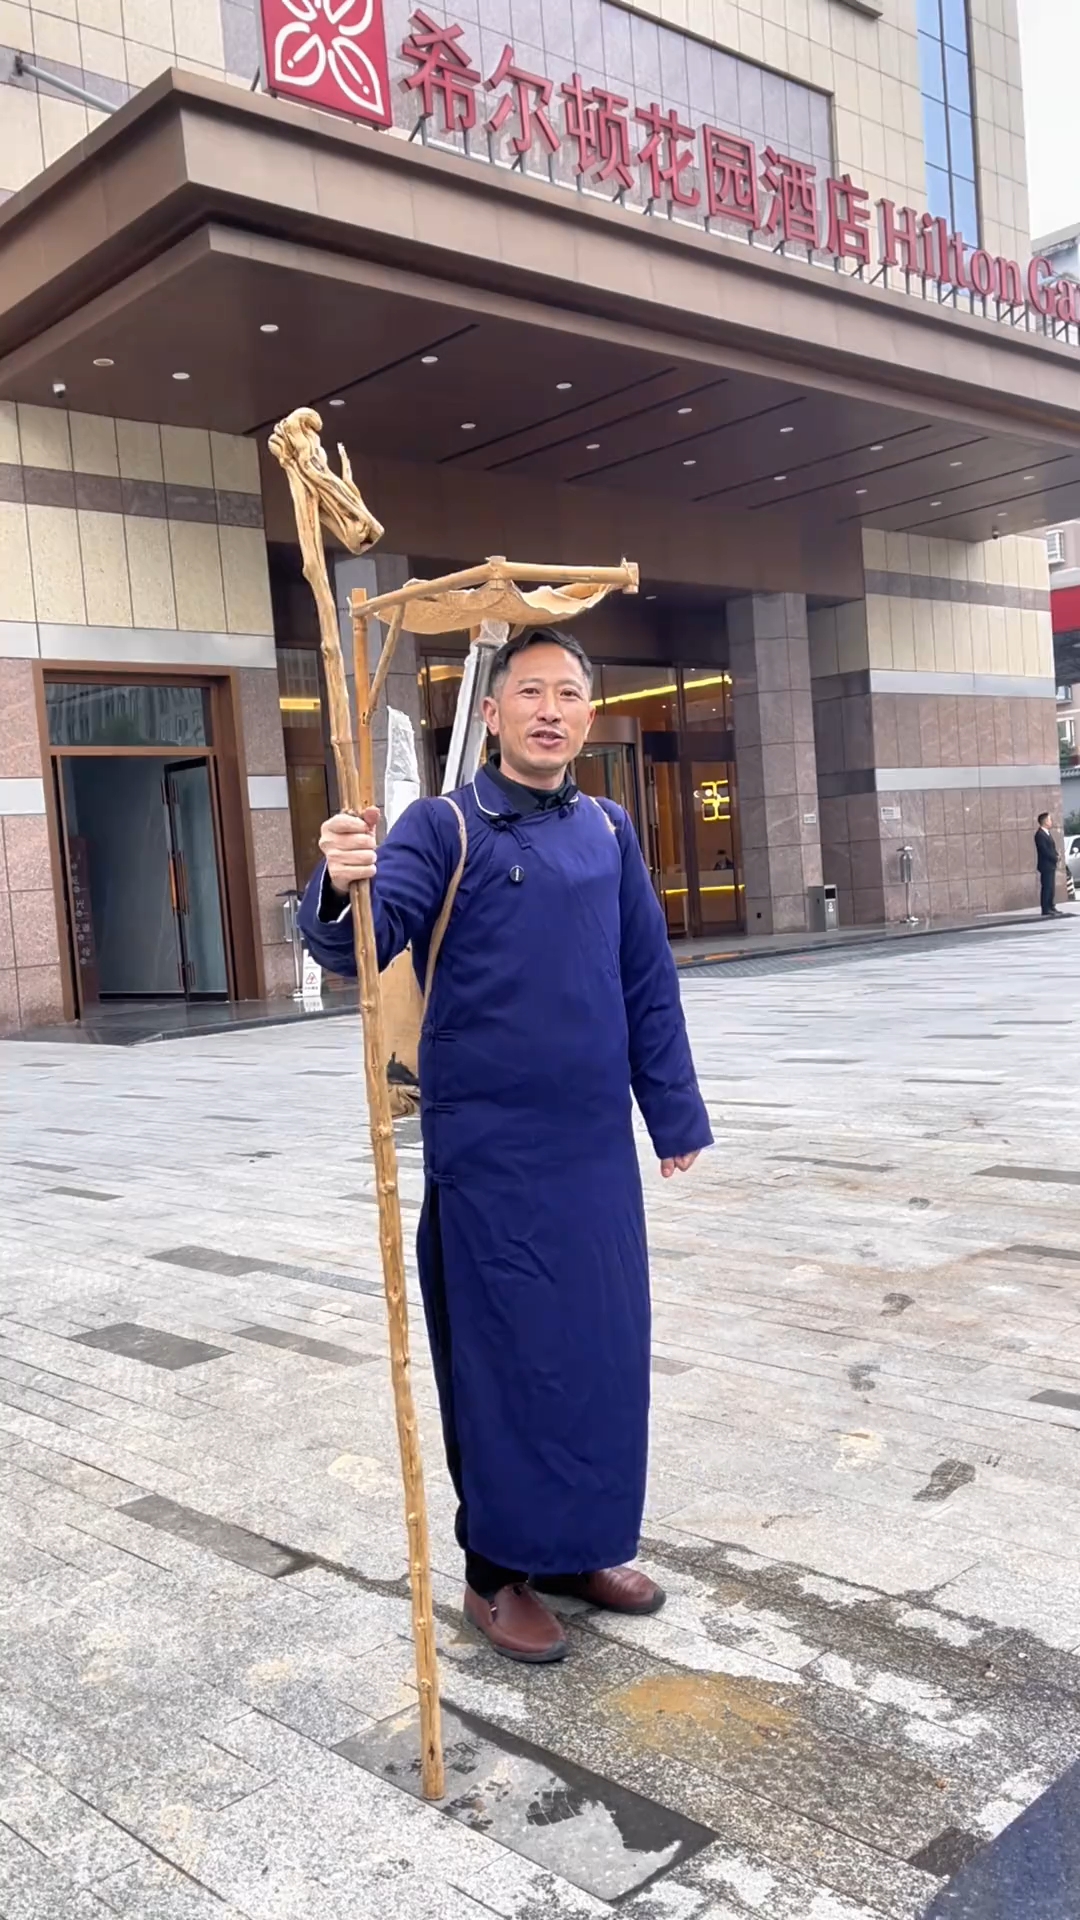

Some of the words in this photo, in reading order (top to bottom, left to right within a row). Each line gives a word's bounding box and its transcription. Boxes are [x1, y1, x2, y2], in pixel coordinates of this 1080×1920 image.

[401, 9, 871, 265] 希尔顿花园酒店
[877, 197, 1023, 307] Hilton
[1027, 255, 1080, 325] Ga
